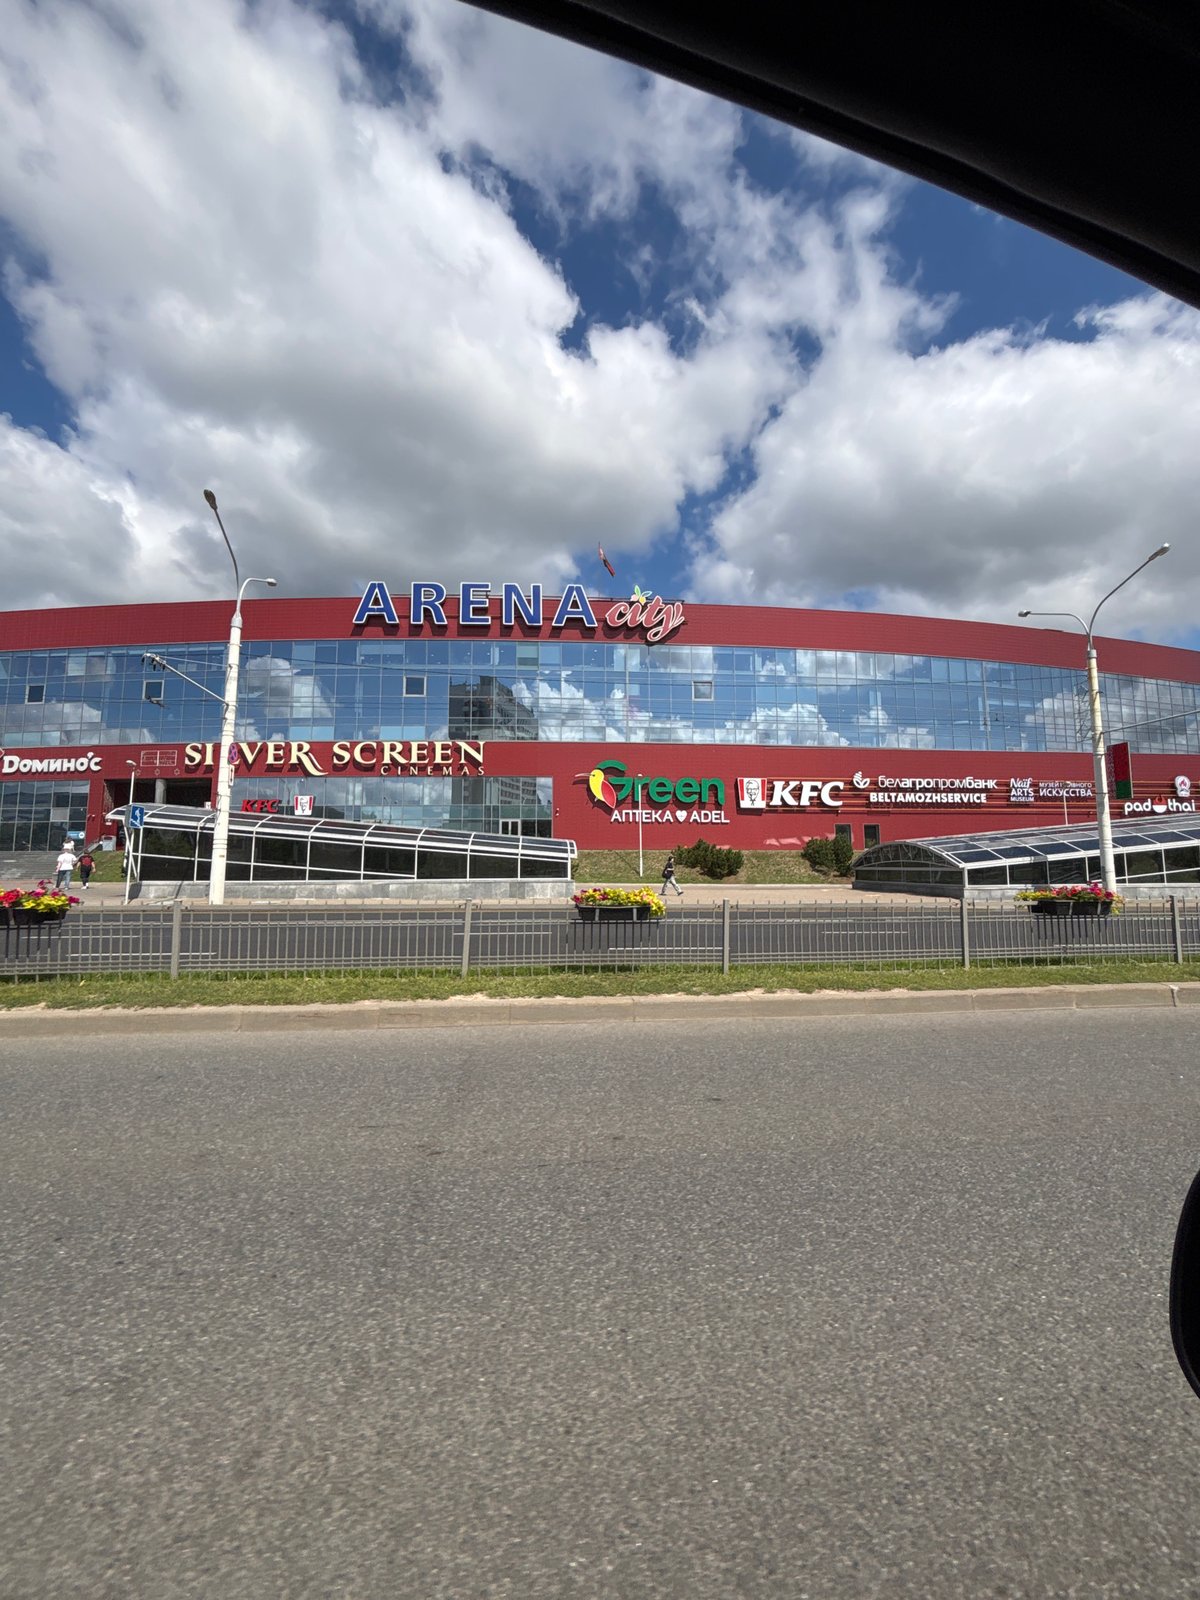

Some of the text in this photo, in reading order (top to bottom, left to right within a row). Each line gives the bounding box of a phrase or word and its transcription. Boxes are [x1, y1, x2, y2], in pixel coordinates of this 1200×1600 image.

[352, 581, 685, 642] ARENA city
[184, 741, 485, 777] SIVER SCREEN
[380, 765, 485, 776] CINEMAS
[590, 759, 726, 806] Green
[878, 775, 998, 791] белагропромбанк
[1010, 777, 1033, 789] Naïf
[769, 780, 845, 807] KFC
[869, 792, 987, 803] BELTAMOZHSERVICE
[1010, 788, 1034, 797] ARTS
[1039, 788, 1093, 797] ИСКУССТВА
[241, 799, 281, 813] KFC
[1124, 798, 1196, 816] pad thai
[610, 809, 674, 823] АПТЕКА
[689, 809, 730, 823] ADEL
